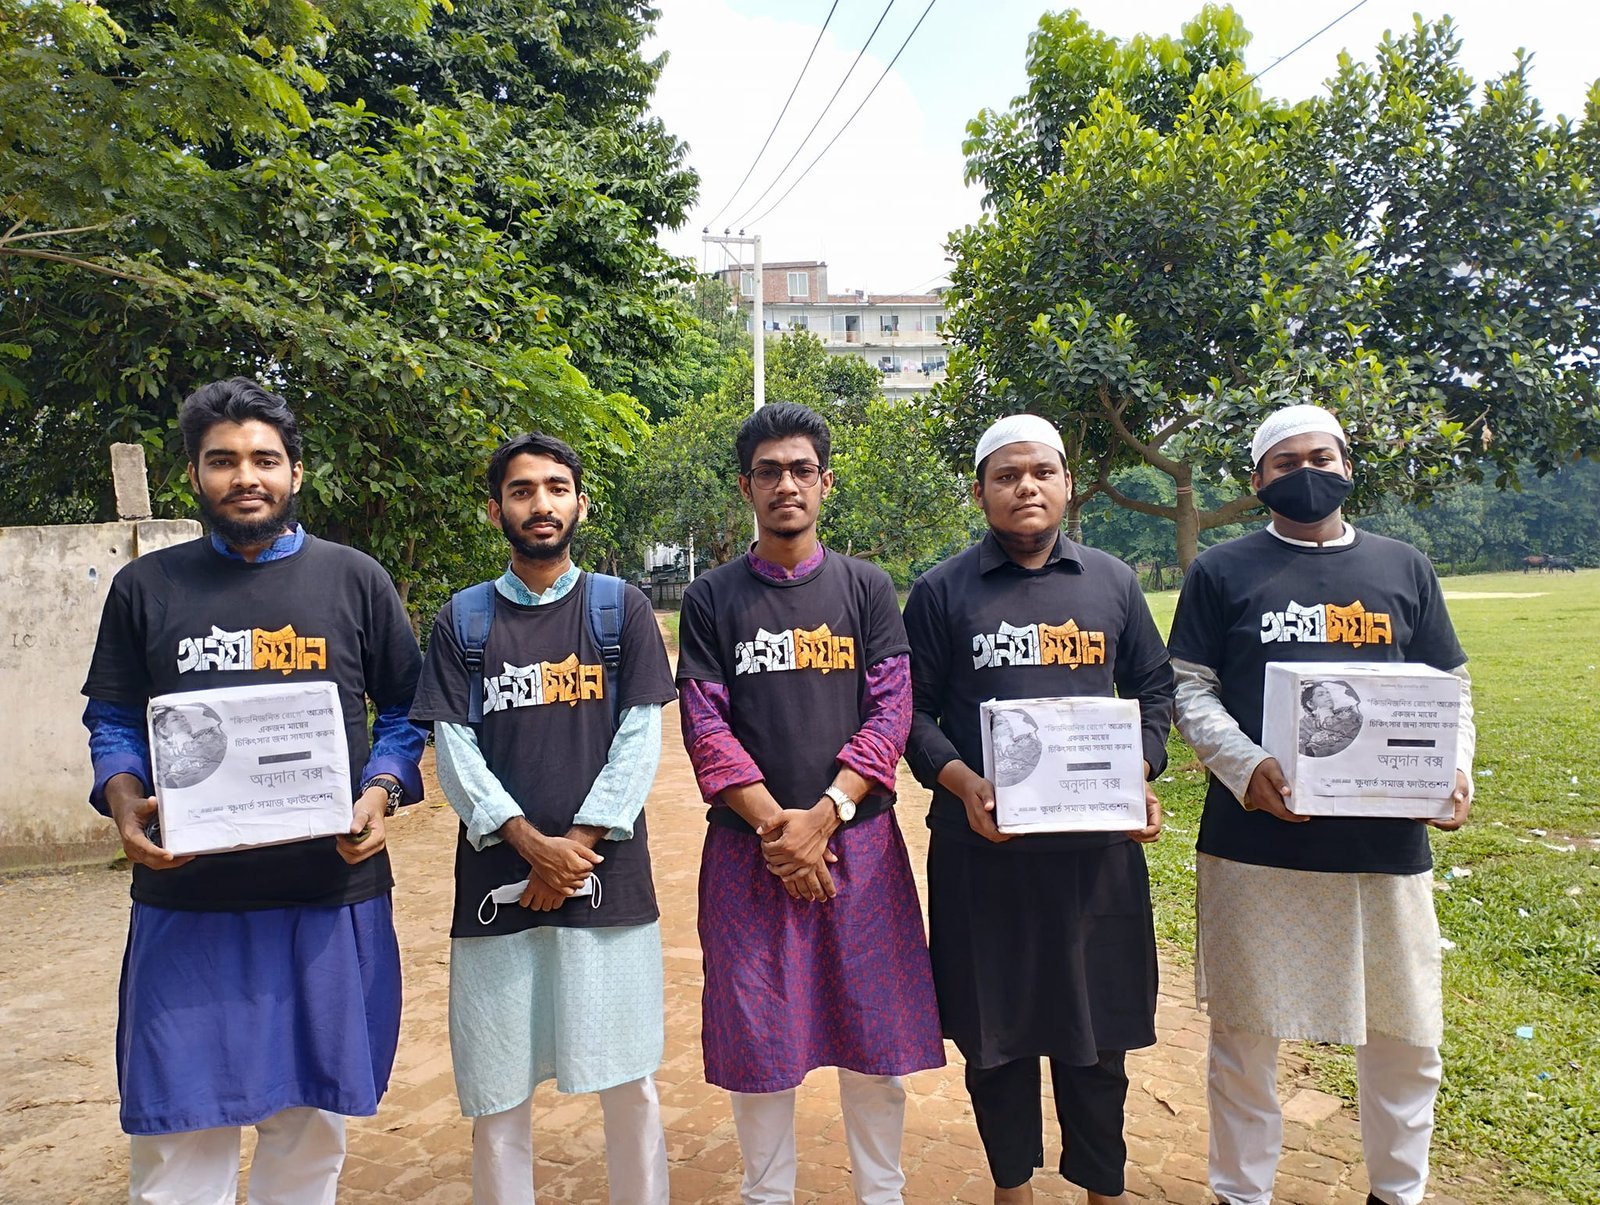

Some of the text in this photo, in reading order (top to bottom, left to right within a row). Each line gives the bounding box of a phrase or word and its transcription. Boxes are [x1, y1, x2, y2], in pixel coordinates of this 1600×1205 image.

[1377, 754, 1444, 770] অনুদান বক্স
[250, 766, 323, 788] অনুদান বক্স
[1380, 779, 1405, 788] সমাজ
[1406, 778, 1449, 789] ফাউন্ডেশন
[1059, 777, 1121, 794] অনুদান বক্স
[256, 797, 284, 809] সমাজ
[286, 791, 334, 806] ফাউন্ডেশন
[1063, 803, 1087, 813] সমাজ
[1087, 801, 1129, 812] ফাউন্ডেশন
